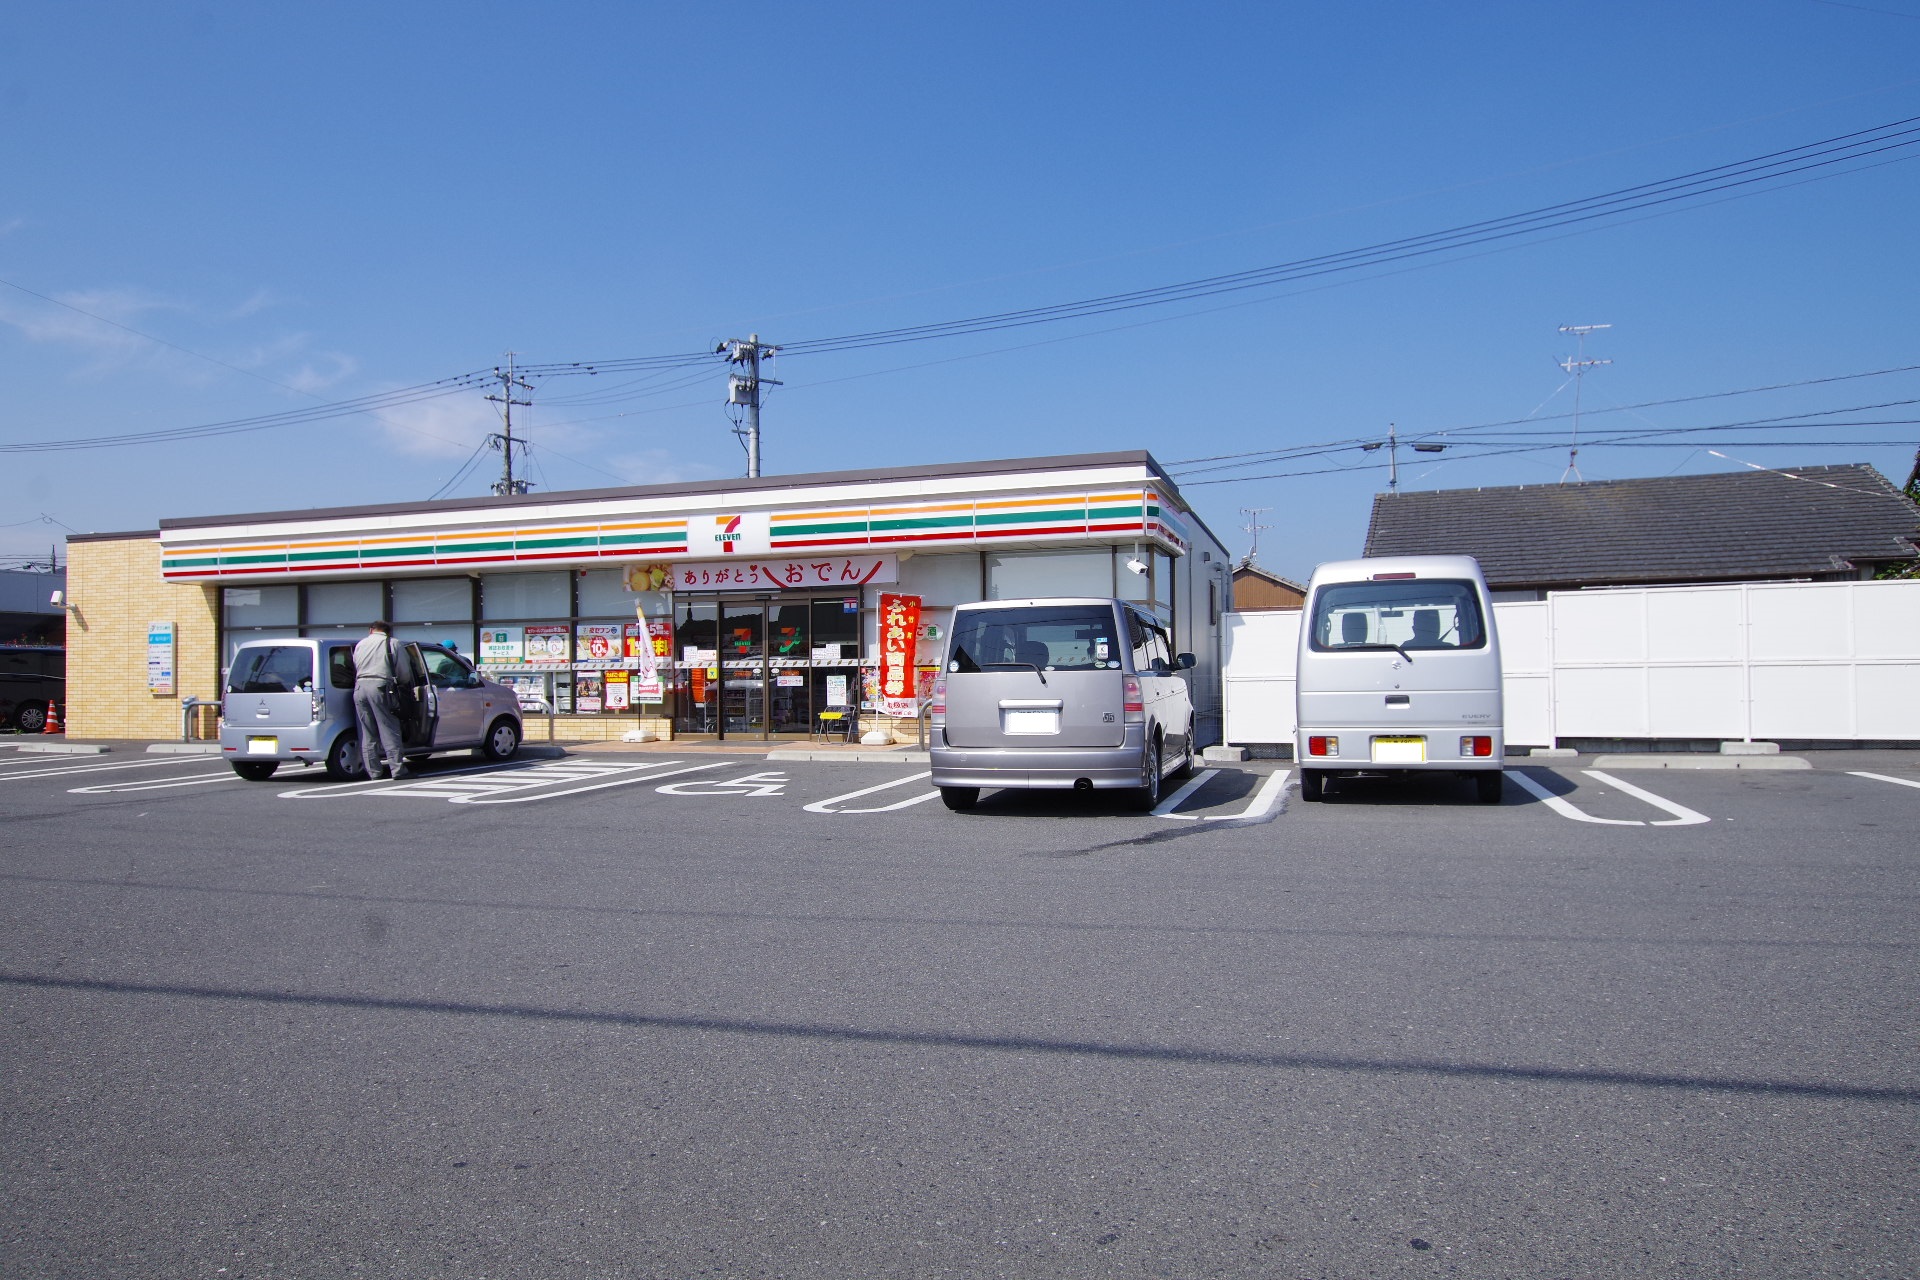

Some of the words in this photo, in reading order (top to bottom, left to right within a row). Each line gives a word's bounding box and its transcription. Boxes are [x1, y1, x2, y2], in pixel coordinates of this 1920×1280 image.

[684, 565, 759, 585] ありがとう
[785, 560, 860, 583] おでん
[927, 626, 937, 636] 酒
[591, 644, 607, 654] 10%
[886, 599, 907, 696] ふれあい商品券
